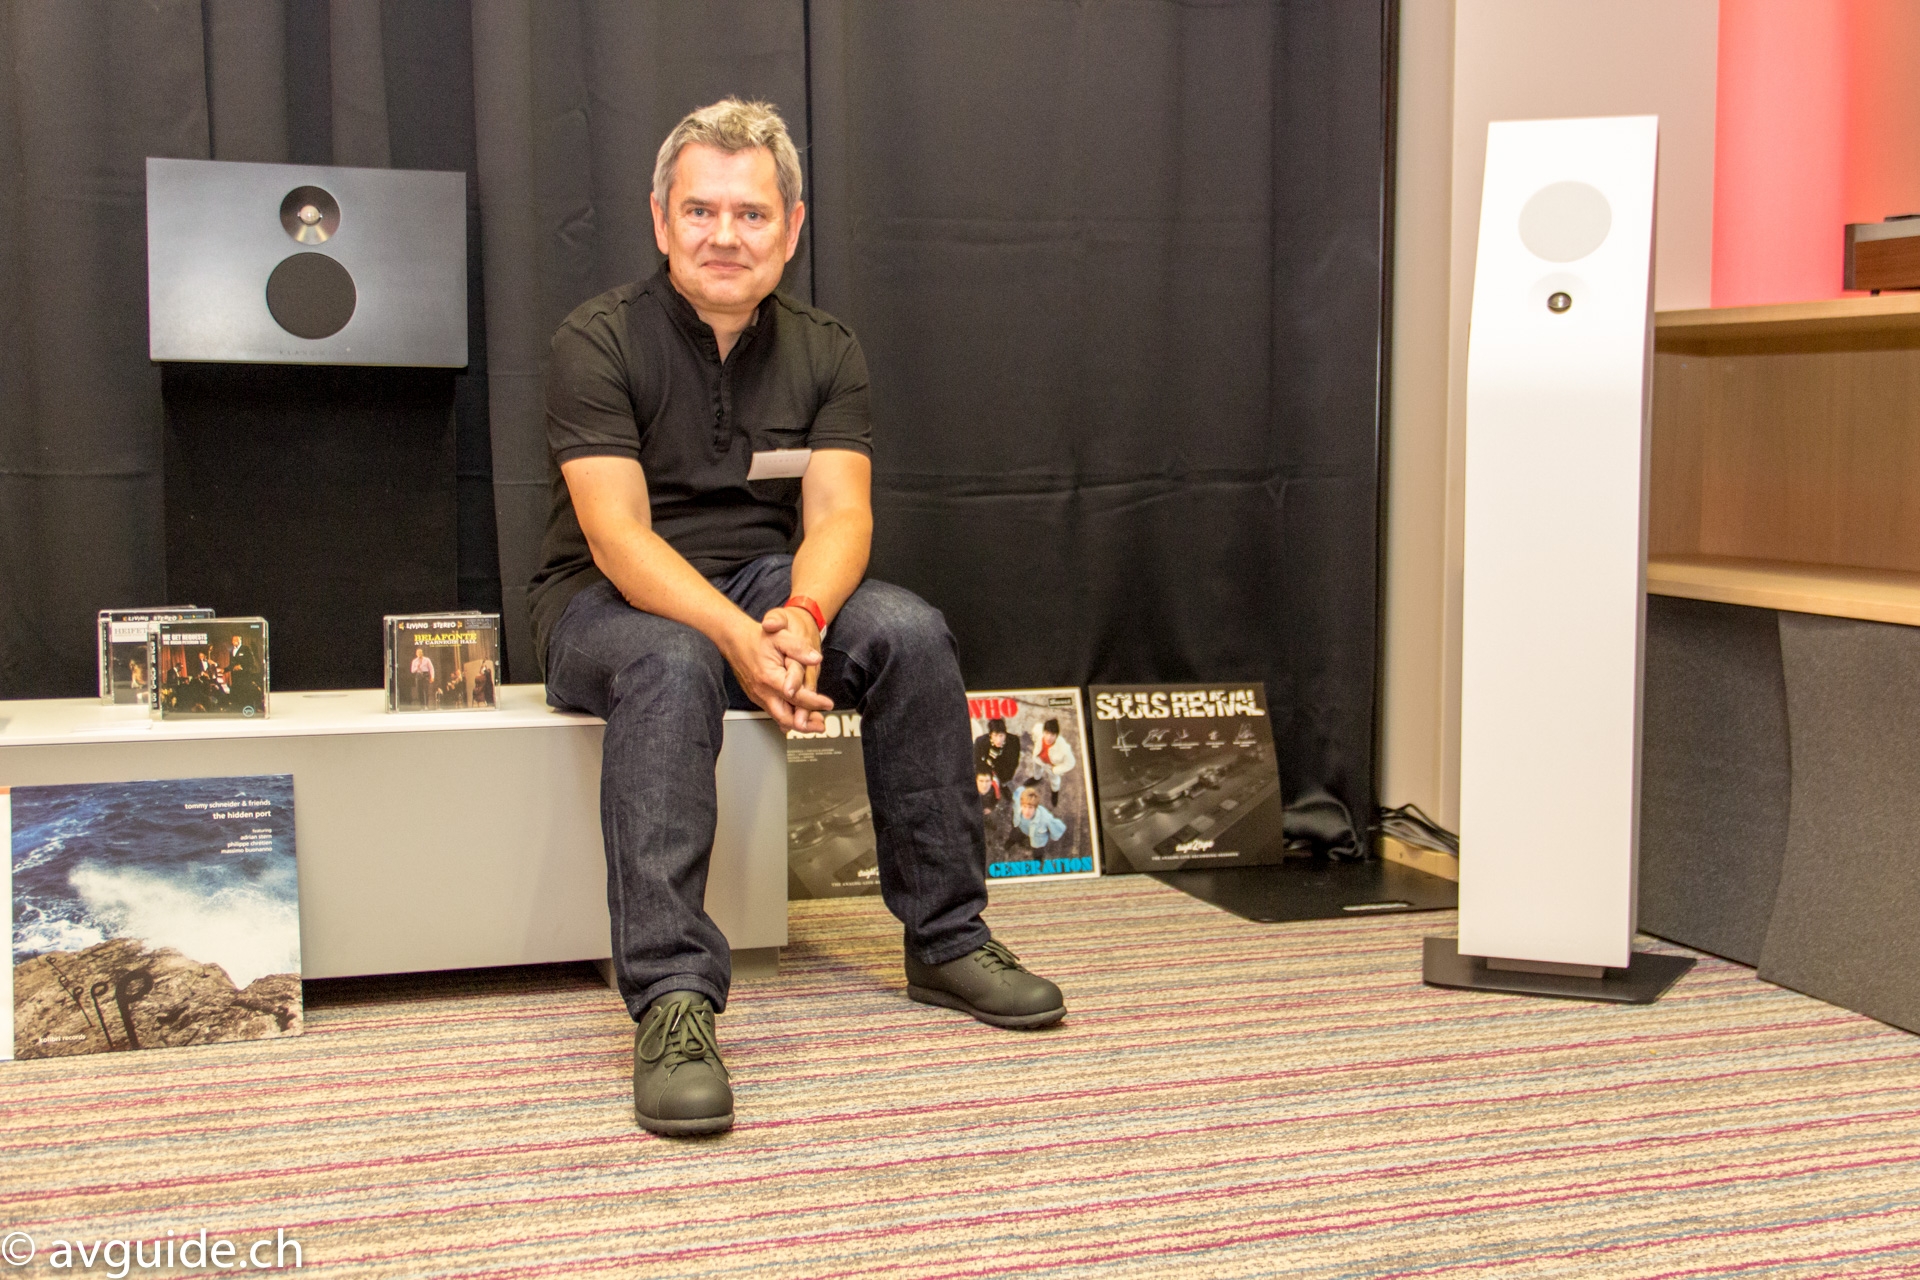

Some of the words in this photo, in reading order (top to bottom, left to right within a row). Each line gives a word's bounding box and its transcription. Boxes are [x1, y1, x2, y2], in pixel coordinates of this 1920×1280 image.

[406, 622, 429, 630] LIVING
[432, 621, 457, 629] STEREO
[414, 632, 477, 642] BELAFONTE
[1096, 692, 1171, 720] SOULS
[1170, 690, 1266, 717] REVIVAL
[255, 810, 272, 818] port
[988, 855, 1093, 878] GENERATION
[39, 1036, 61, 1045] kolibri
